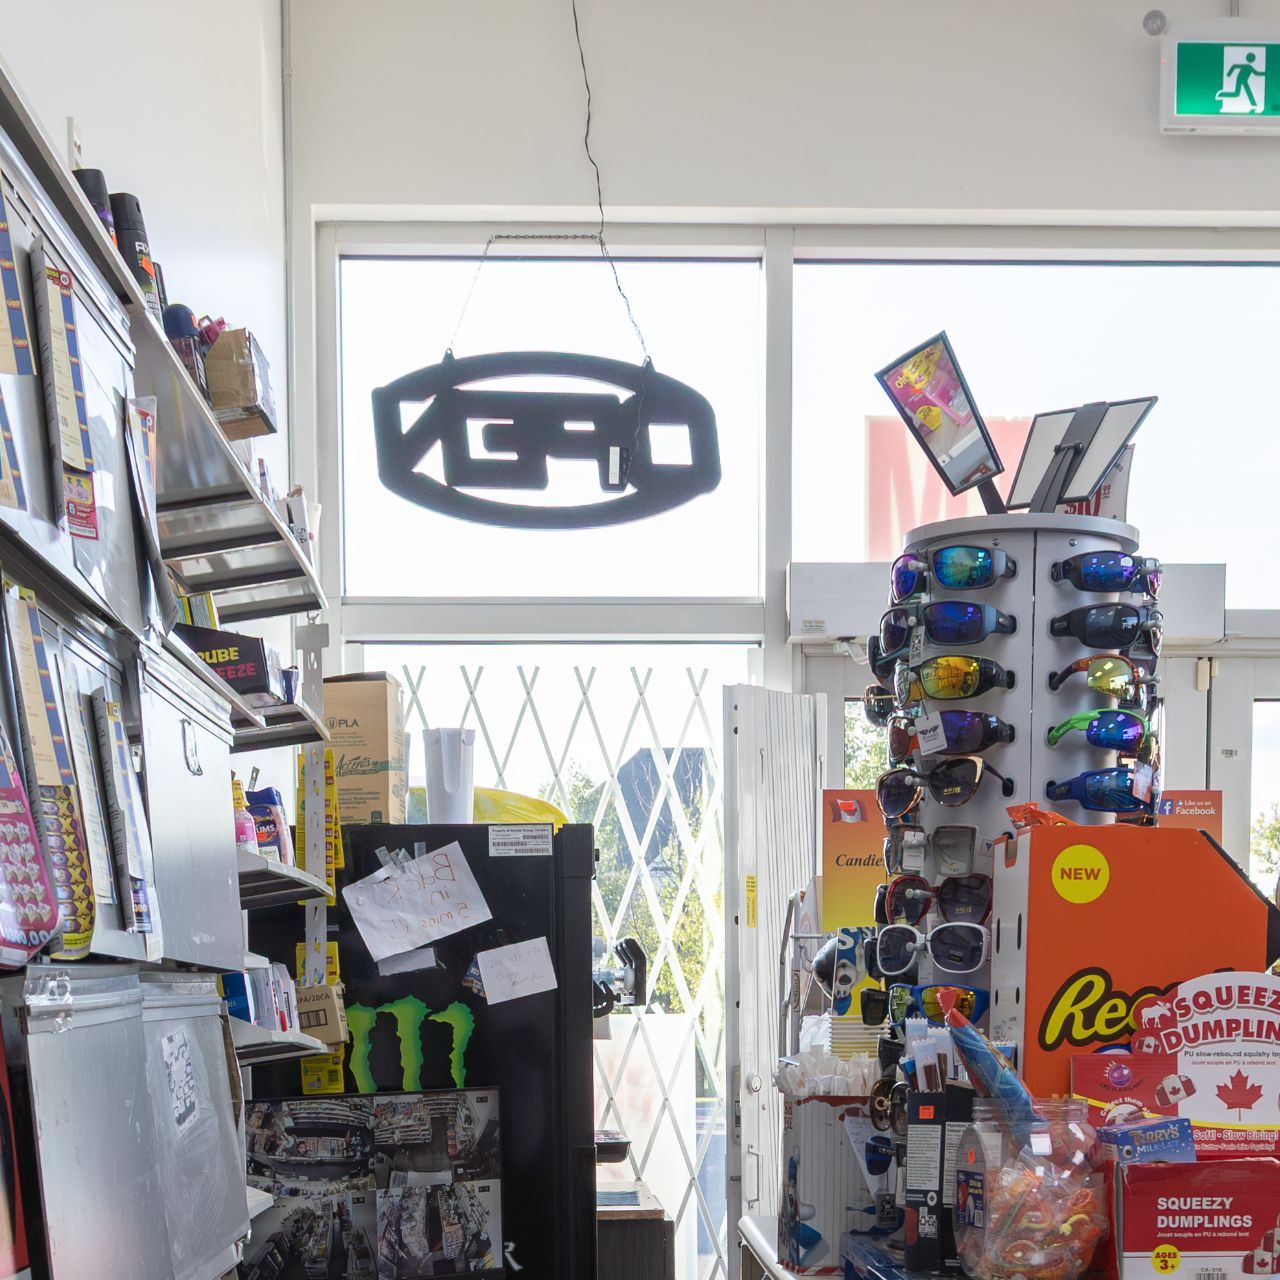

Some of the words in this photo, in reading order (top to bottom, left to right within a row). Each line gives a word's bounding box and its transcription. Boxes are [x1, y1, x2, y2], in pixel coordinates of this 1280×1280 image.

[338, 719, 360, 728] PLA
[1176, 806, 1216, 815] Facebook
[256, 823, 276, 834] UMS
[1060, 867, 1102, 881] NEW
[1243, 1051, 1270, 1059] squishy
[1124, 1097, 1143, 1106] them
[1193, 1130, 1217, 1140] Soft!
[1223, 1130, 1246, 1140] Slow
[1247, 1130, 1279, 1141] Rising!
[1157, 1197, 1234, 1210] SQUEEZY
[1157, 1215, 1253, 1229] DUMPLINGS
[1160, 1259, 1176, 1270] 3+
